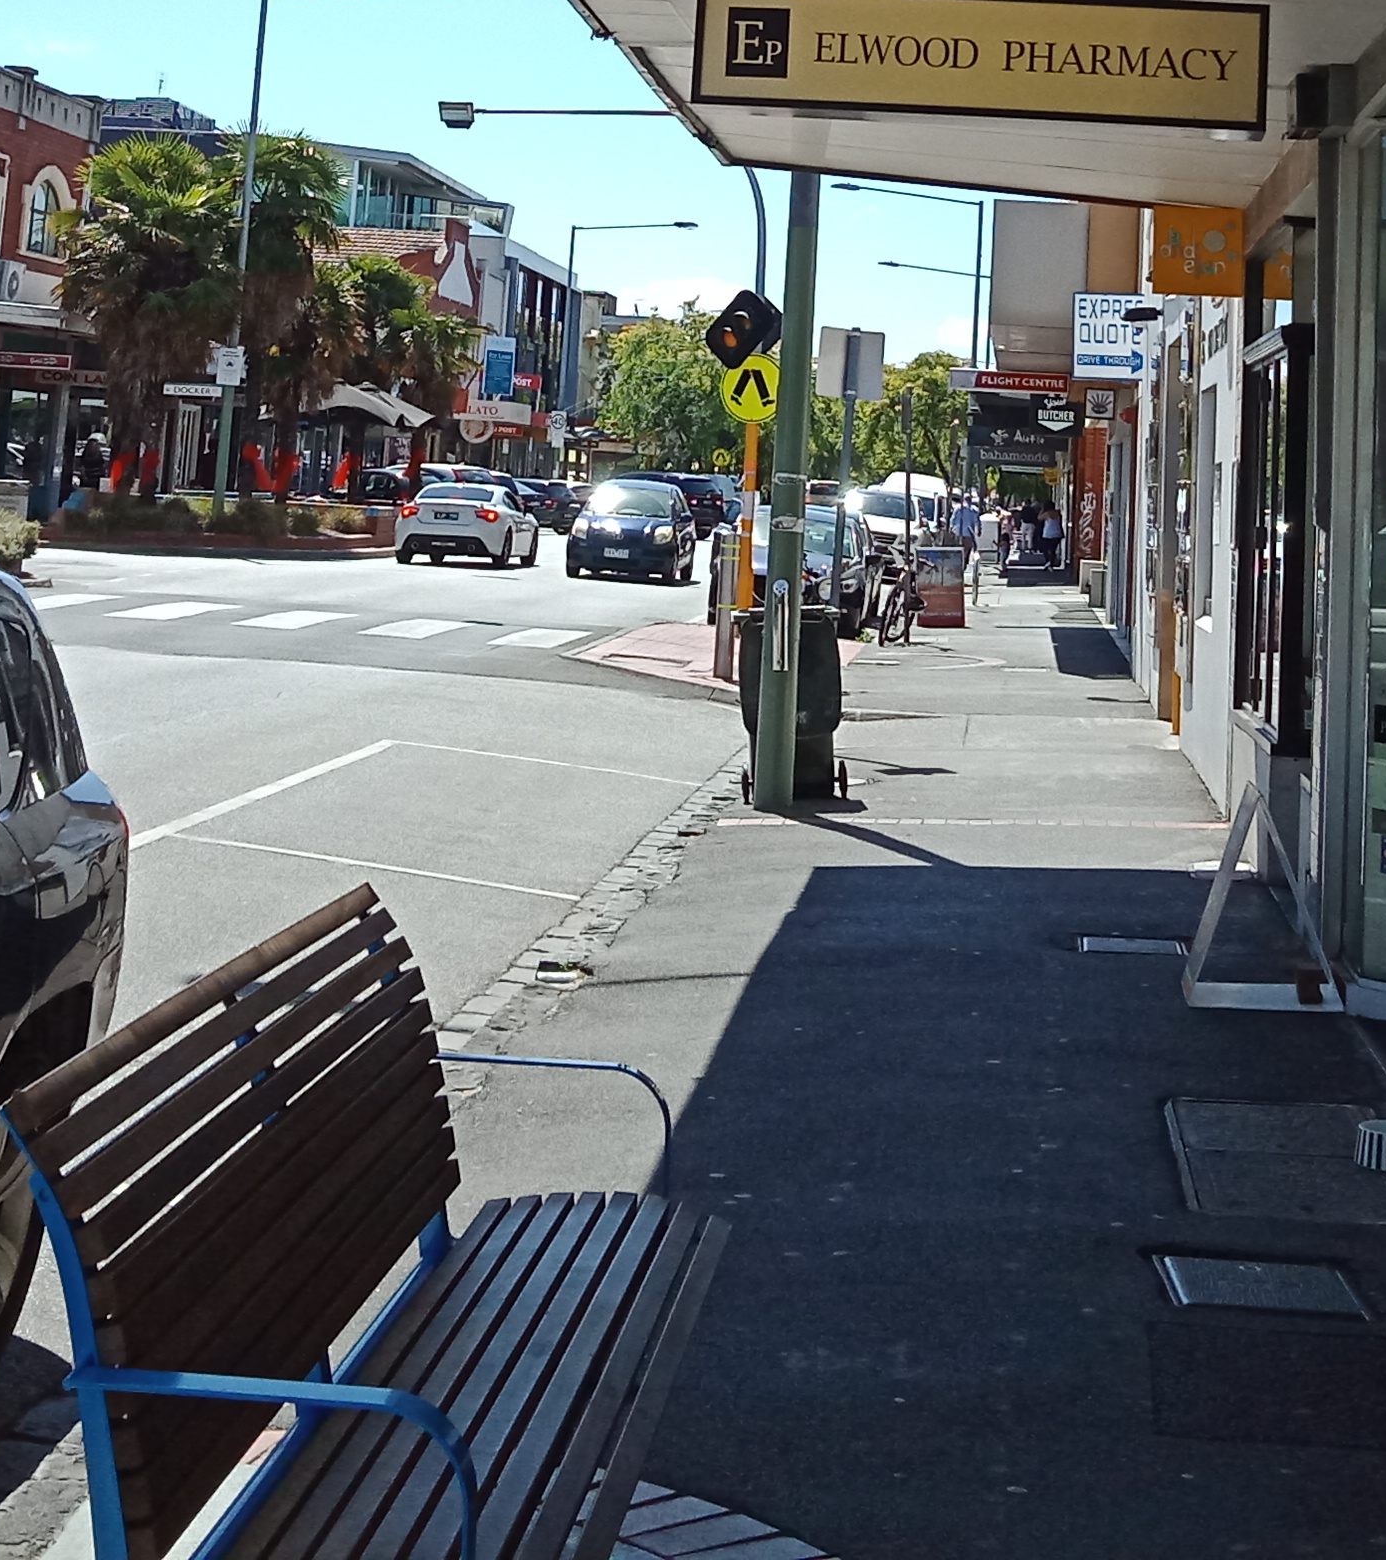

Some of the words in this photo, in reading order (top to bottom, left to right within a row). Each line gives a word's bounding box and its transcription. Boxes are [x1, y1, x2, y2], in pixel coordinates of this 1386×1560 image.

[813, 31, 979, 70] ELWOOD
[1002, 40, 1239, 82] PHARMACY
[1079, 323, 1142, 345] QUOTE
[1077, 355, 1100, 364] DRIVE
[1103, 356, 1141, 366] THROUGH
[42, 370, 78, 384] COIN
[84, 374, 107, 385] LA
[981, 375, 1021, 387] FLIGHT
[1022, 376, 1064, 389] CENTRE
[173, 385, 211, 396] DOCKER
[468, 405, 499, 416] LATO
[1037, 408, 1075, 422] BUTCHER
[979, 447, 1050, 463] bahamonde
